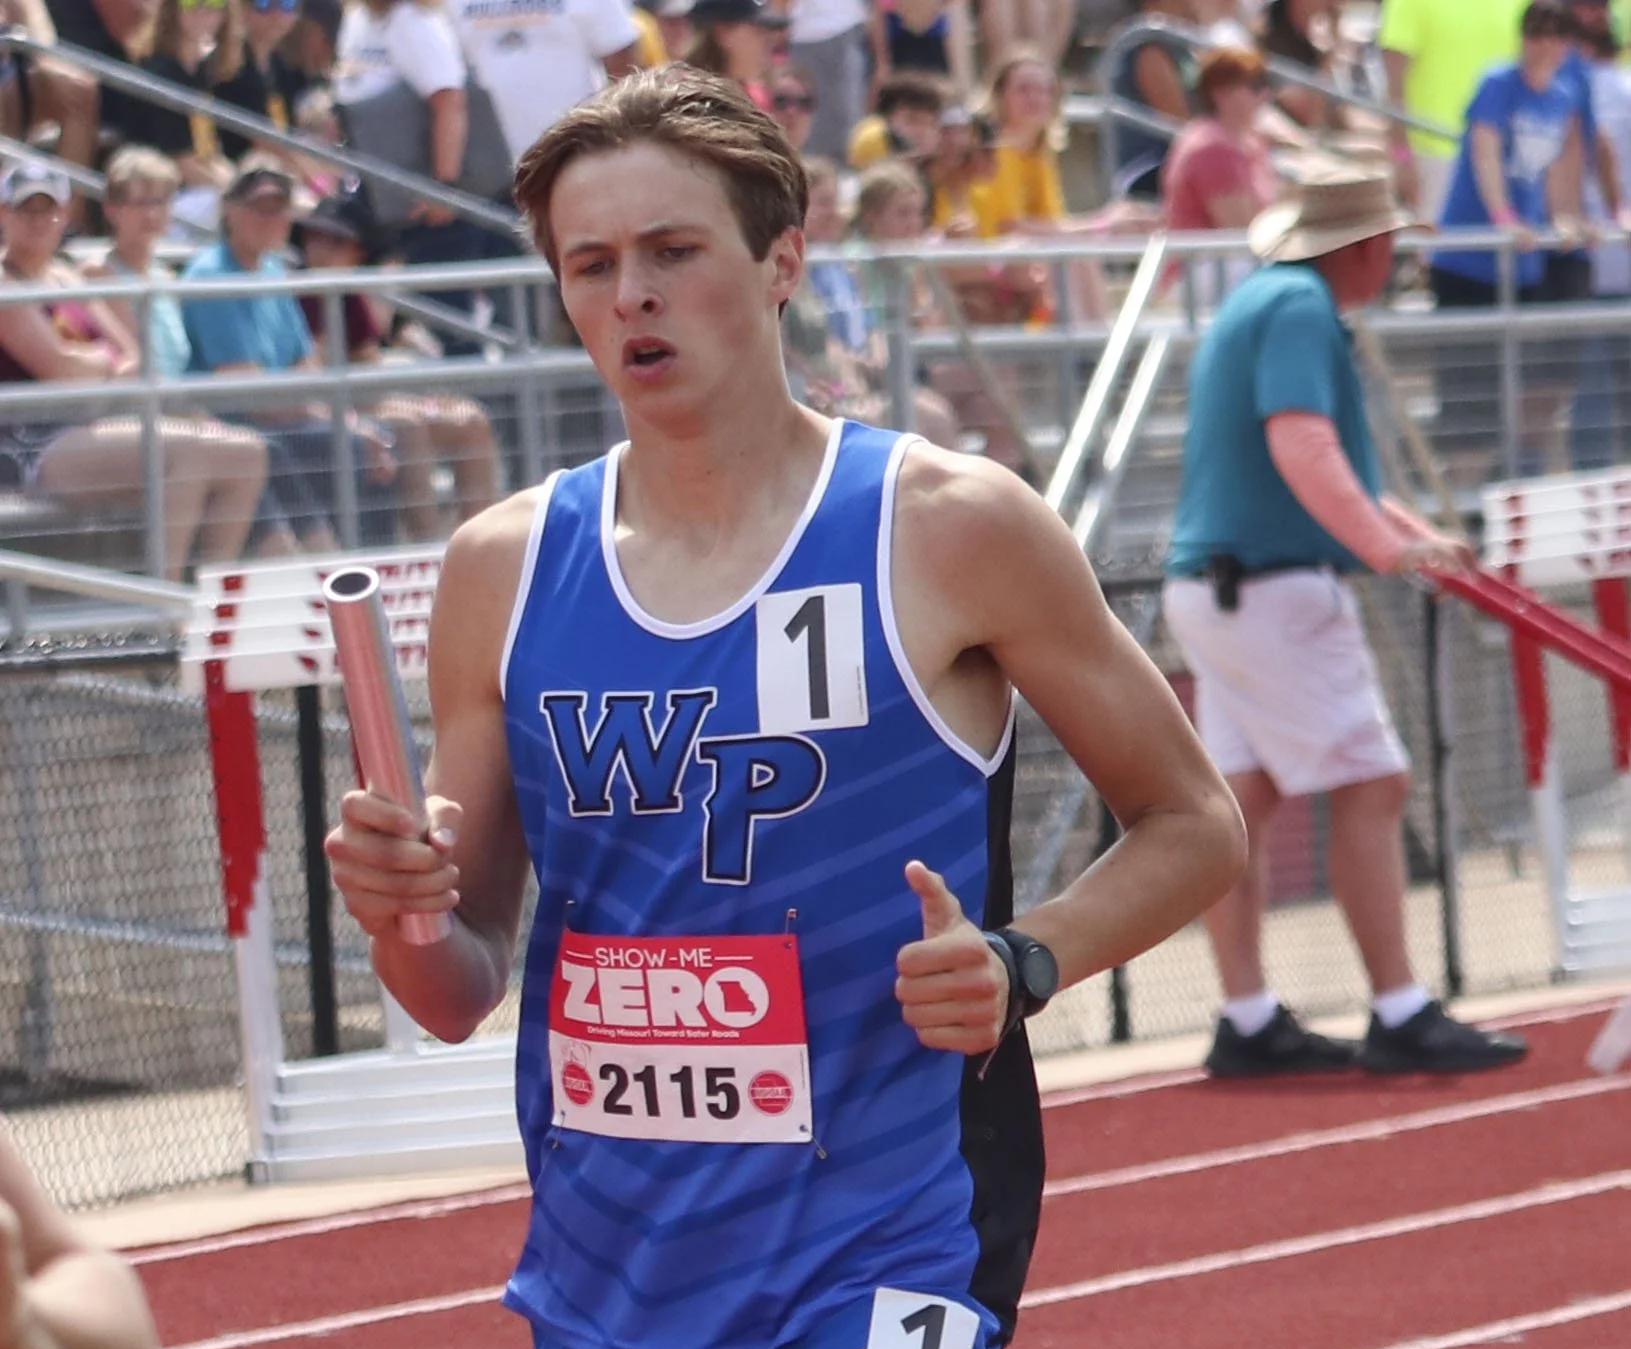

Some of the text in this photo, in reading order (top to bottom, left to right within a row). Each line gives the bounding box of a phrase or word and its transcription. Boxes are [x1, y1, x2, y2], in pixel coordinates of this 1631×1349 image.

[784, 594, 830, 721] 1
[595, 946, 713, 968] SHOW-ME
[561, 960, 770, 1029] ZERO
[599, 1063, 741, 1120] 2115
